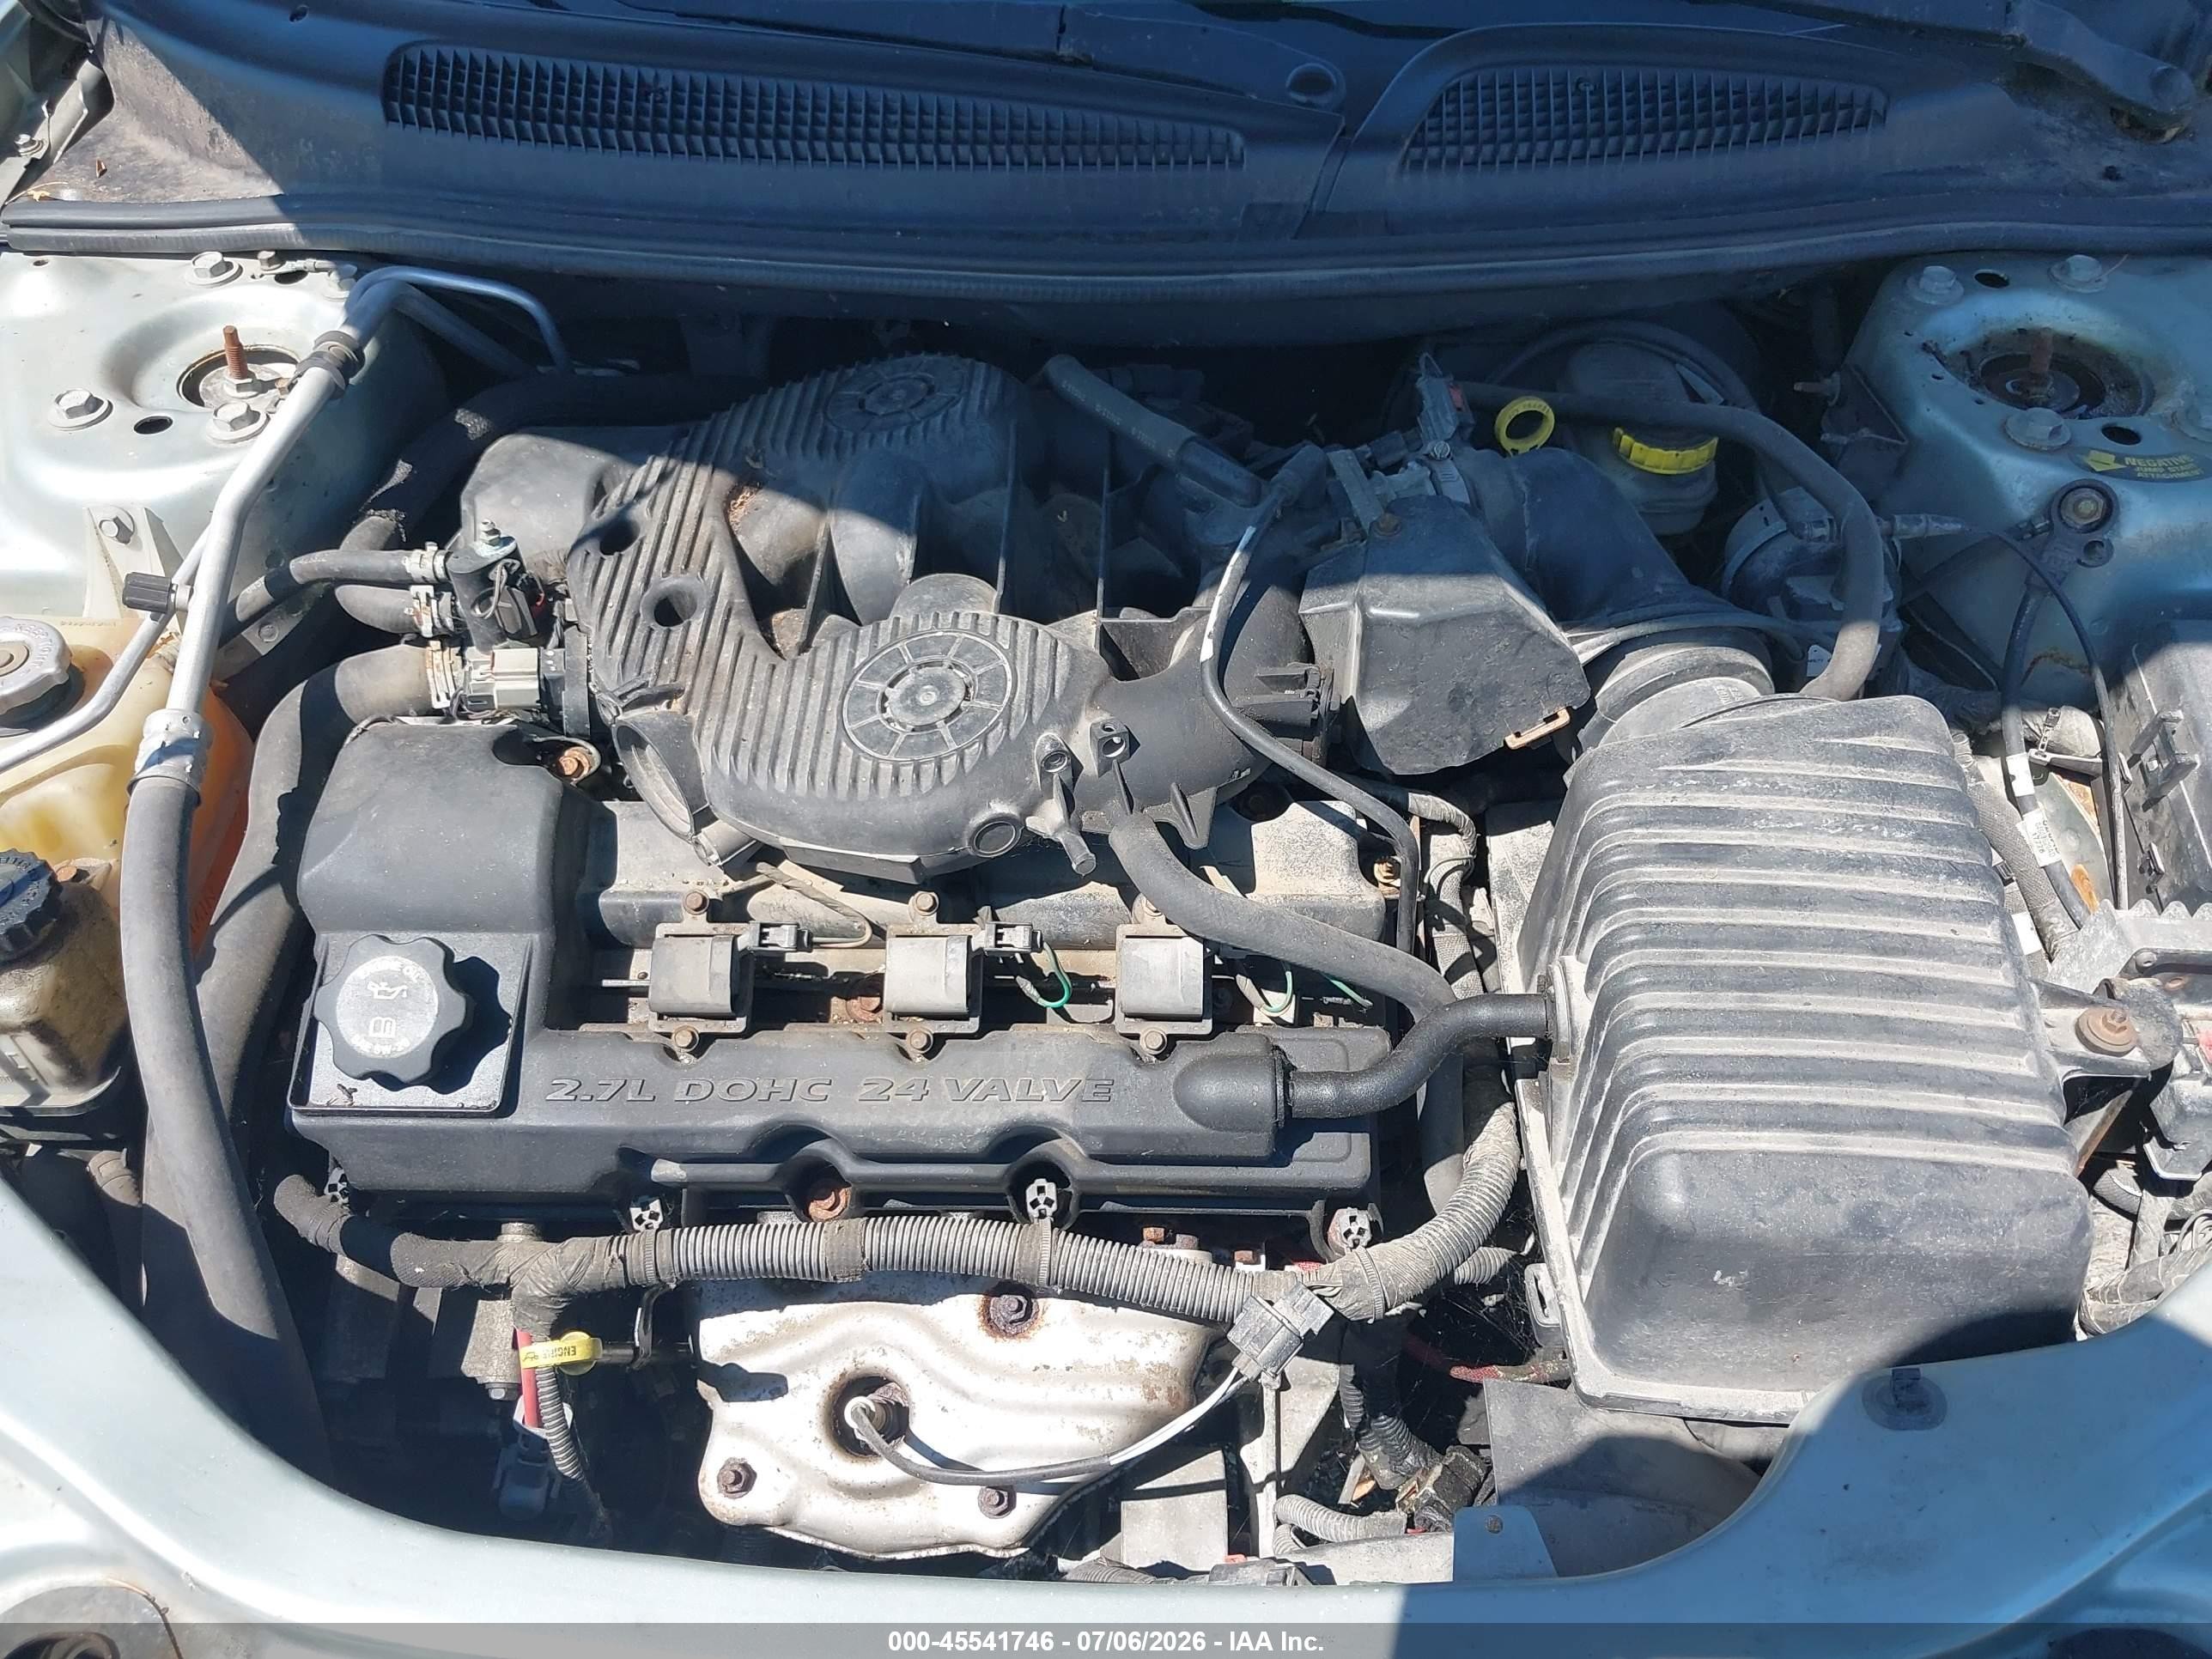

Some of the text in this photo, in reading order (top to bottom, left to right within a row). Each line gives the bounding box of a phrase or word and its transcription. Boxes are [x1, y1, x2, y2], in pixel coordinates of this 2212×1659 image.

[2124, 454, 2194, 467] NEGATIVE
[403, 964, 420, 984] OIL
[545, 1078, 1115, 1103] 2.7L DOHC 24 VALVE
